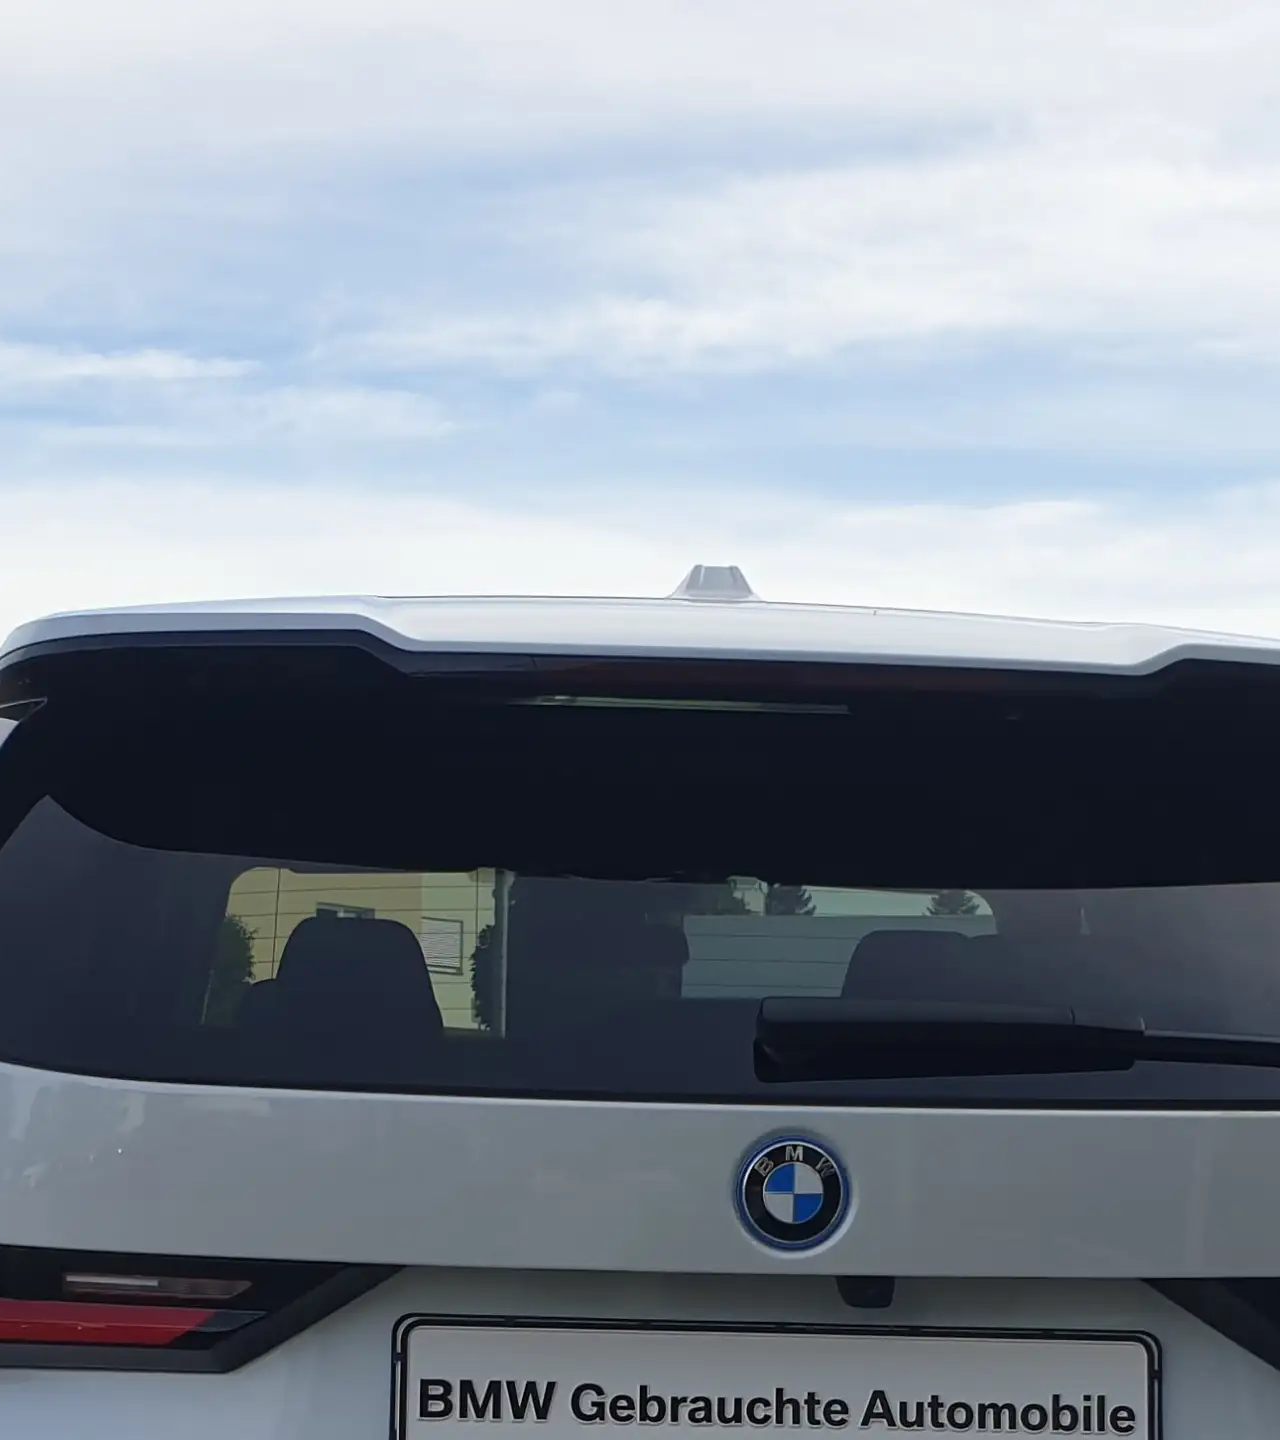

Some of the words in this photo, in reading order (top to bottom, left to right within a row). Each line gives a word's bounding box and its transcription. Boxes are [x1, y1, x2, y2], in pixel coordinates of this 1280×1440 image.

[754, 1145, 835, 1180] BMW
[419, 1378, 557, 1421] BMW
[570, 1382, 850, 1427] Gebrauchte
[860, 1388, 1136, 1434] Automobile
